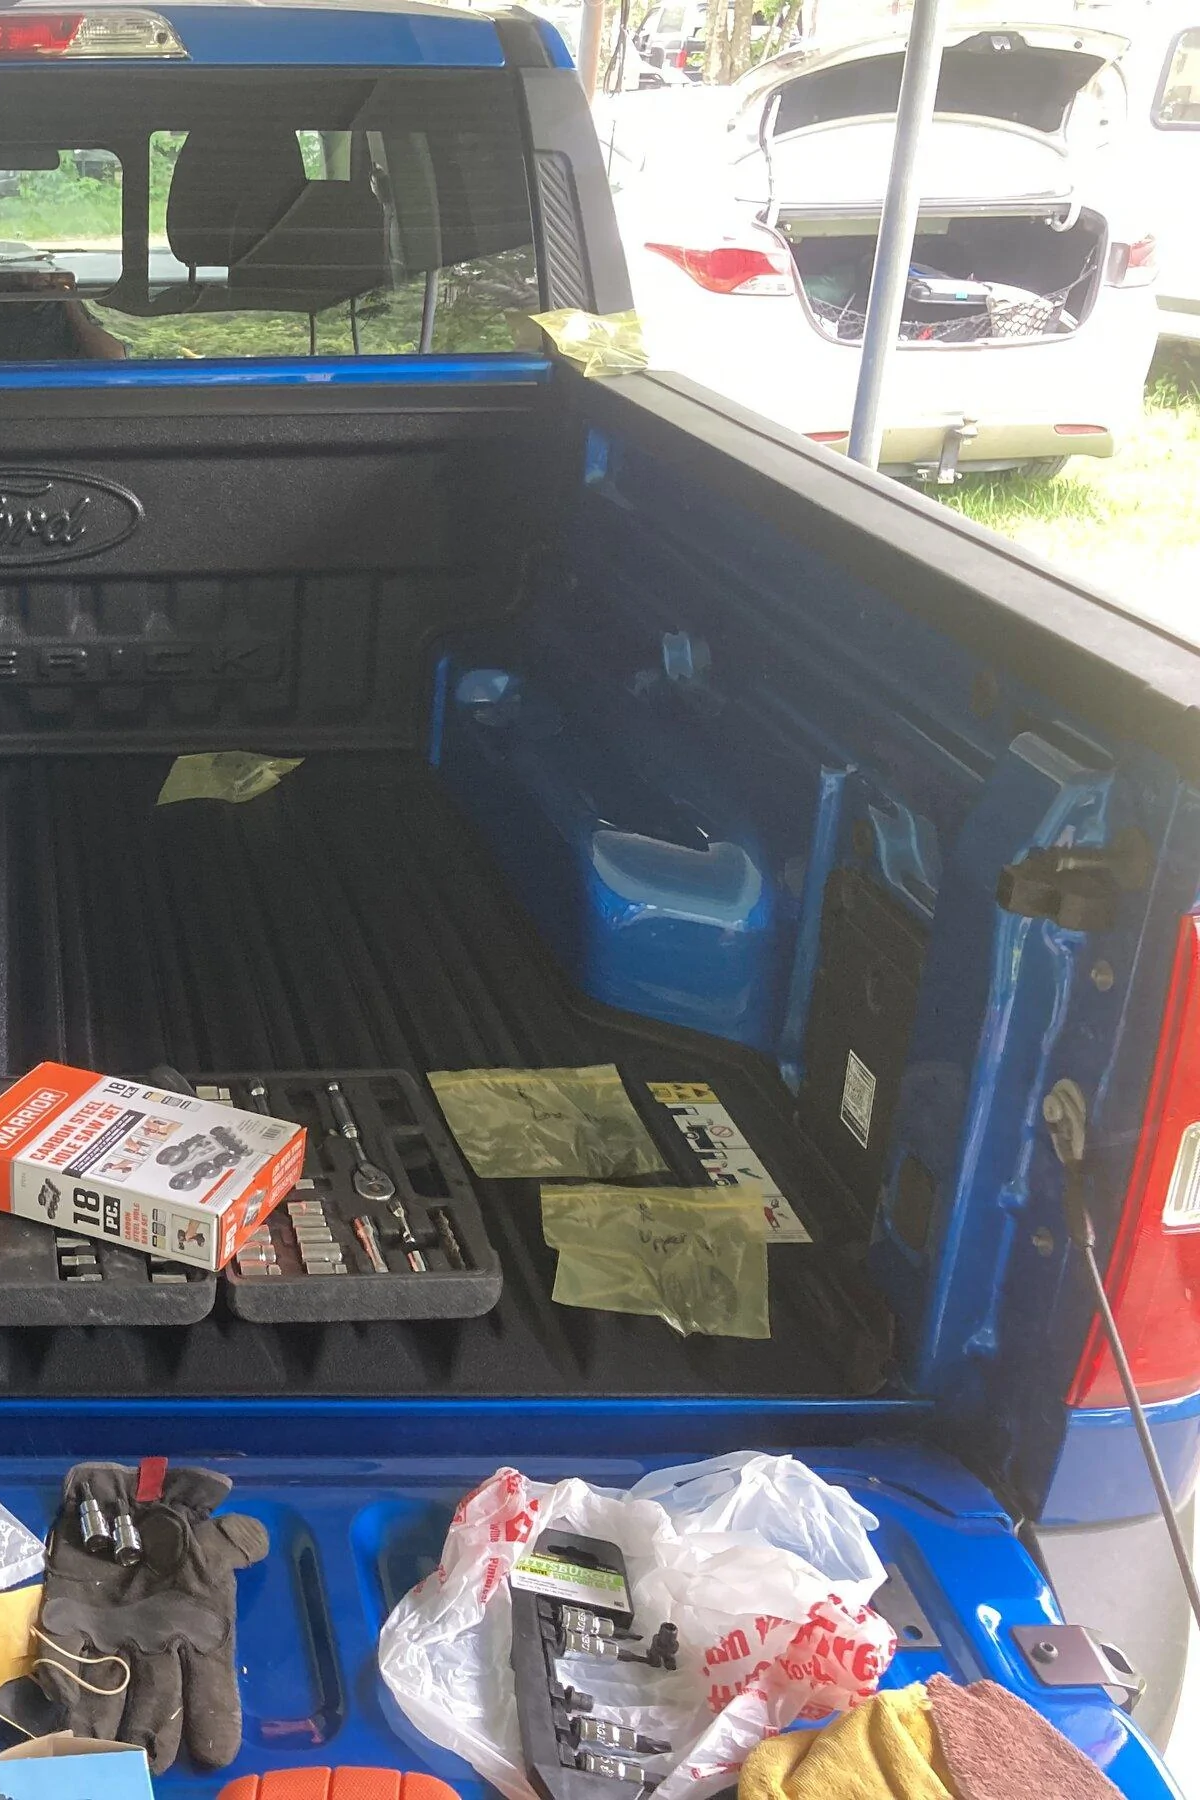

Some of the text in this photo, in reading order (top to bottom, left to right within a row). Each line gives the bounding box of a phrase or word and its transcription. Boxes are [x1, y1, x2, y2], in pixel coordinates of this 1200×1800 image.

[103, 1082, 127, 1094] 18
[29, 1124, 75, 1161] CARBON
[71, 1100, 105, 1129] STEEL
[48, 1140, 82, 1166] HOLE
[78, 1118, 104, 1142] SAW
[102, 1103, 124, 1121] SET
[73, 1187, 118, 1230] 18 PC.
